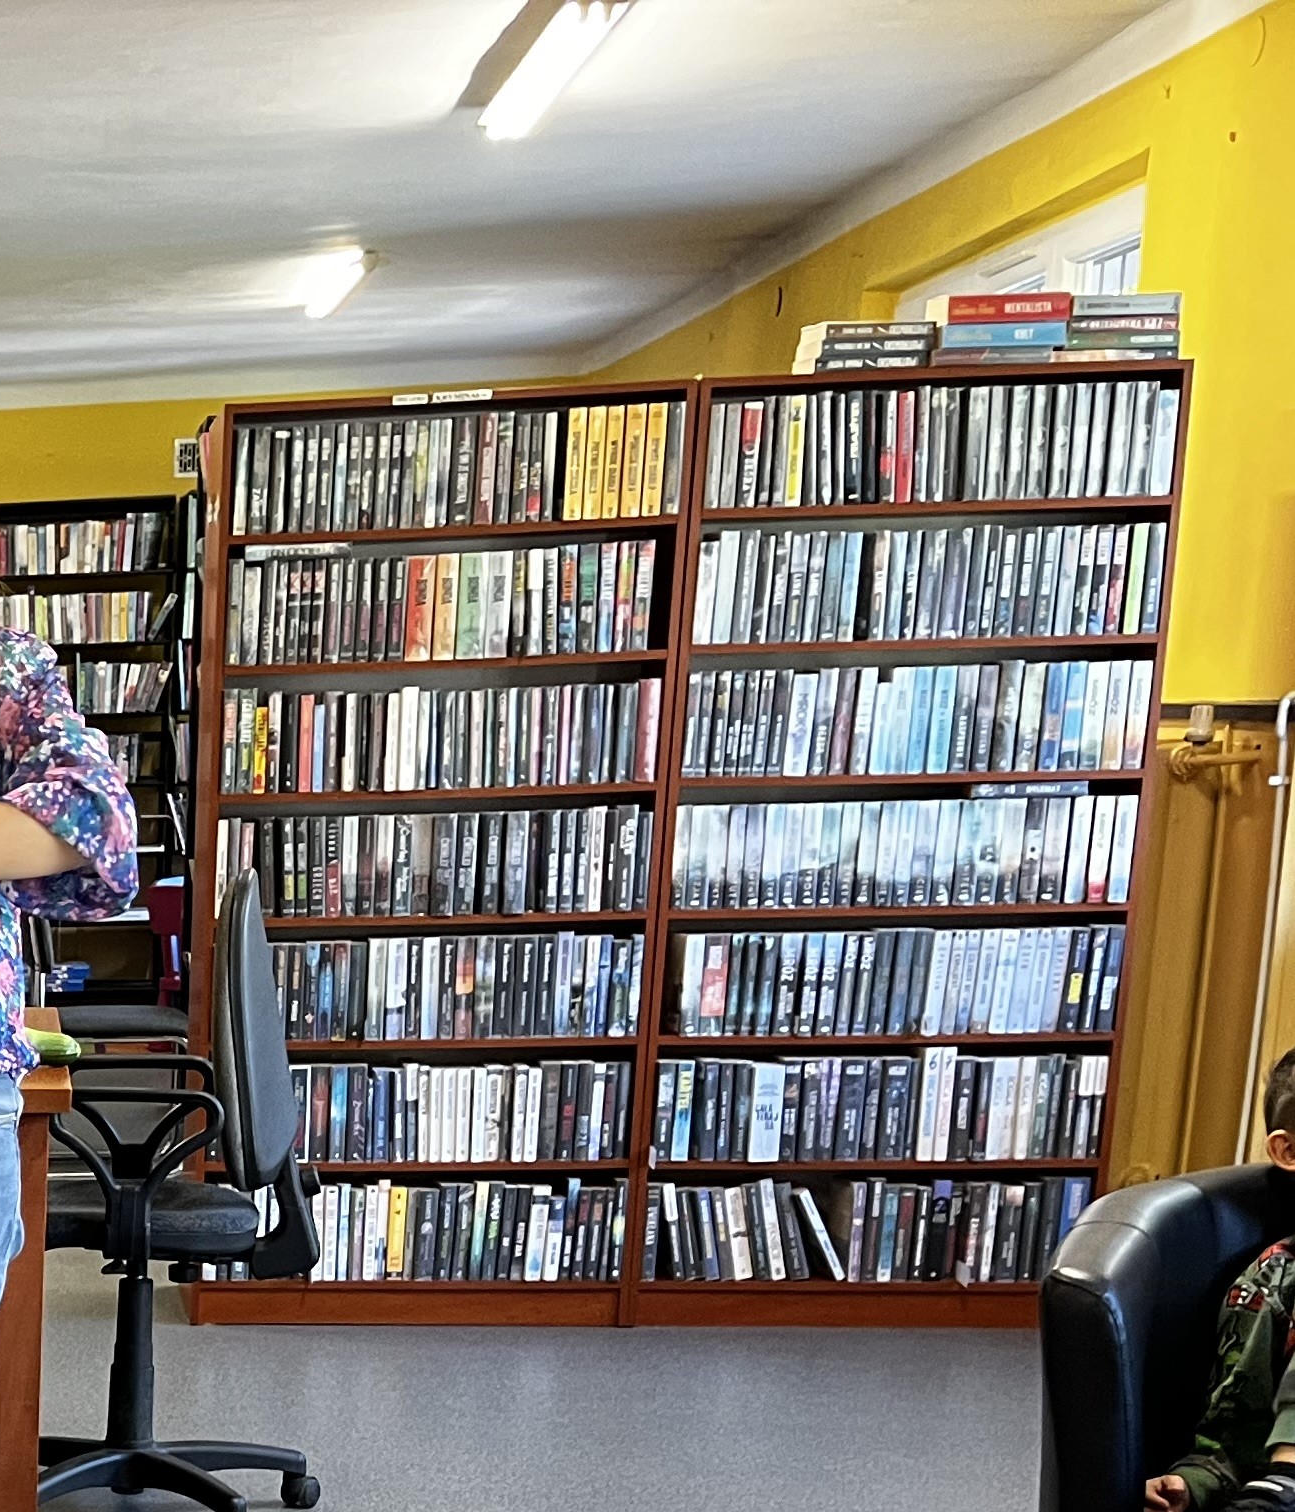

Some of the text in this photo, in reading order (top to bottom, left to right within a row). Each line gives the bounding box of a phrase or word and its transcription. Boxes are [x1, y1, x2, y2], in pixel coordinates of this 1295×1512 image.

[1110, 678, 1121, 714] MRÓZ
[780, 947, 799, 982] MRÓZ
[803, 946, 820, 981] MRÓZ
[822, 946, 839, 982] MRÓZ
[843, 935, 859, 968] MRÓZ
[860, 936, 875, 970] MRÓZ
